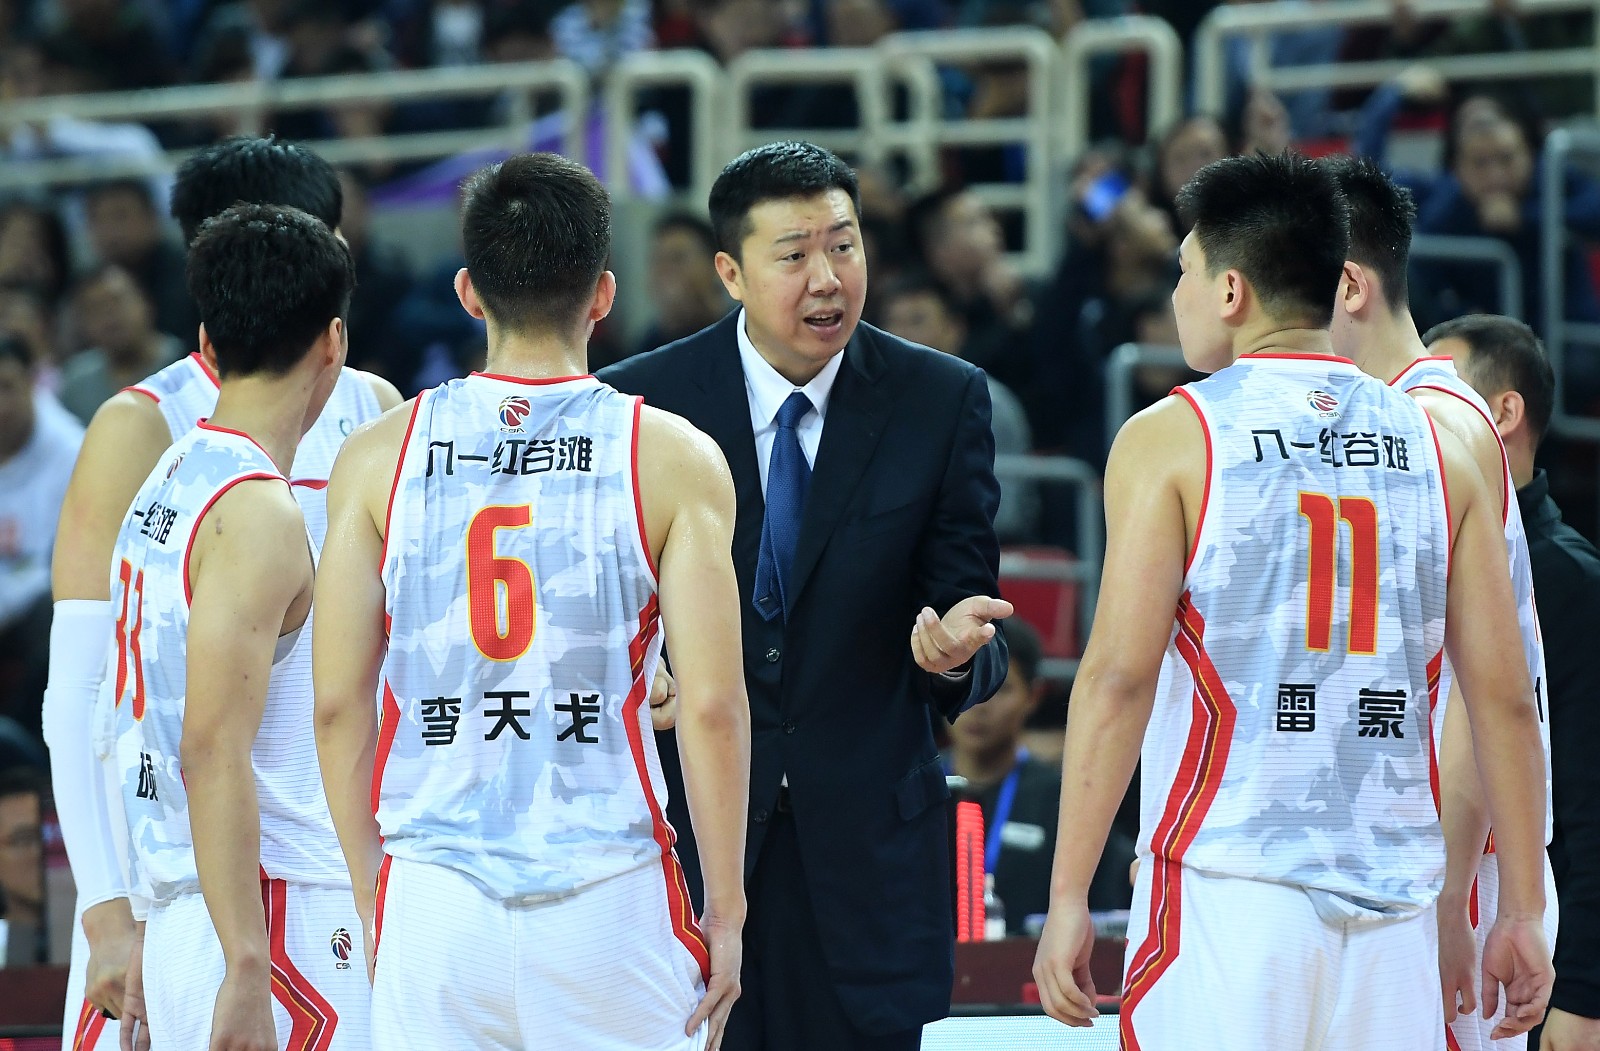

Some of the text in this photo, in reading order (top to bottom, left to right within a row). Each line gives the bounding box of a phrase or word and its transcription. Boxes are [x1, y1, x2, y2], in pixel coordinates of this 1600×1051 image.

[426, 435, 592, 477] 八一红谷滩
[466, 503, 536, 662] 6
[1298, 490, 1379, 655] 11
[421, 691, 600, 745] 李天戈
[1276, 683, 1407, 739] 雷蒙
